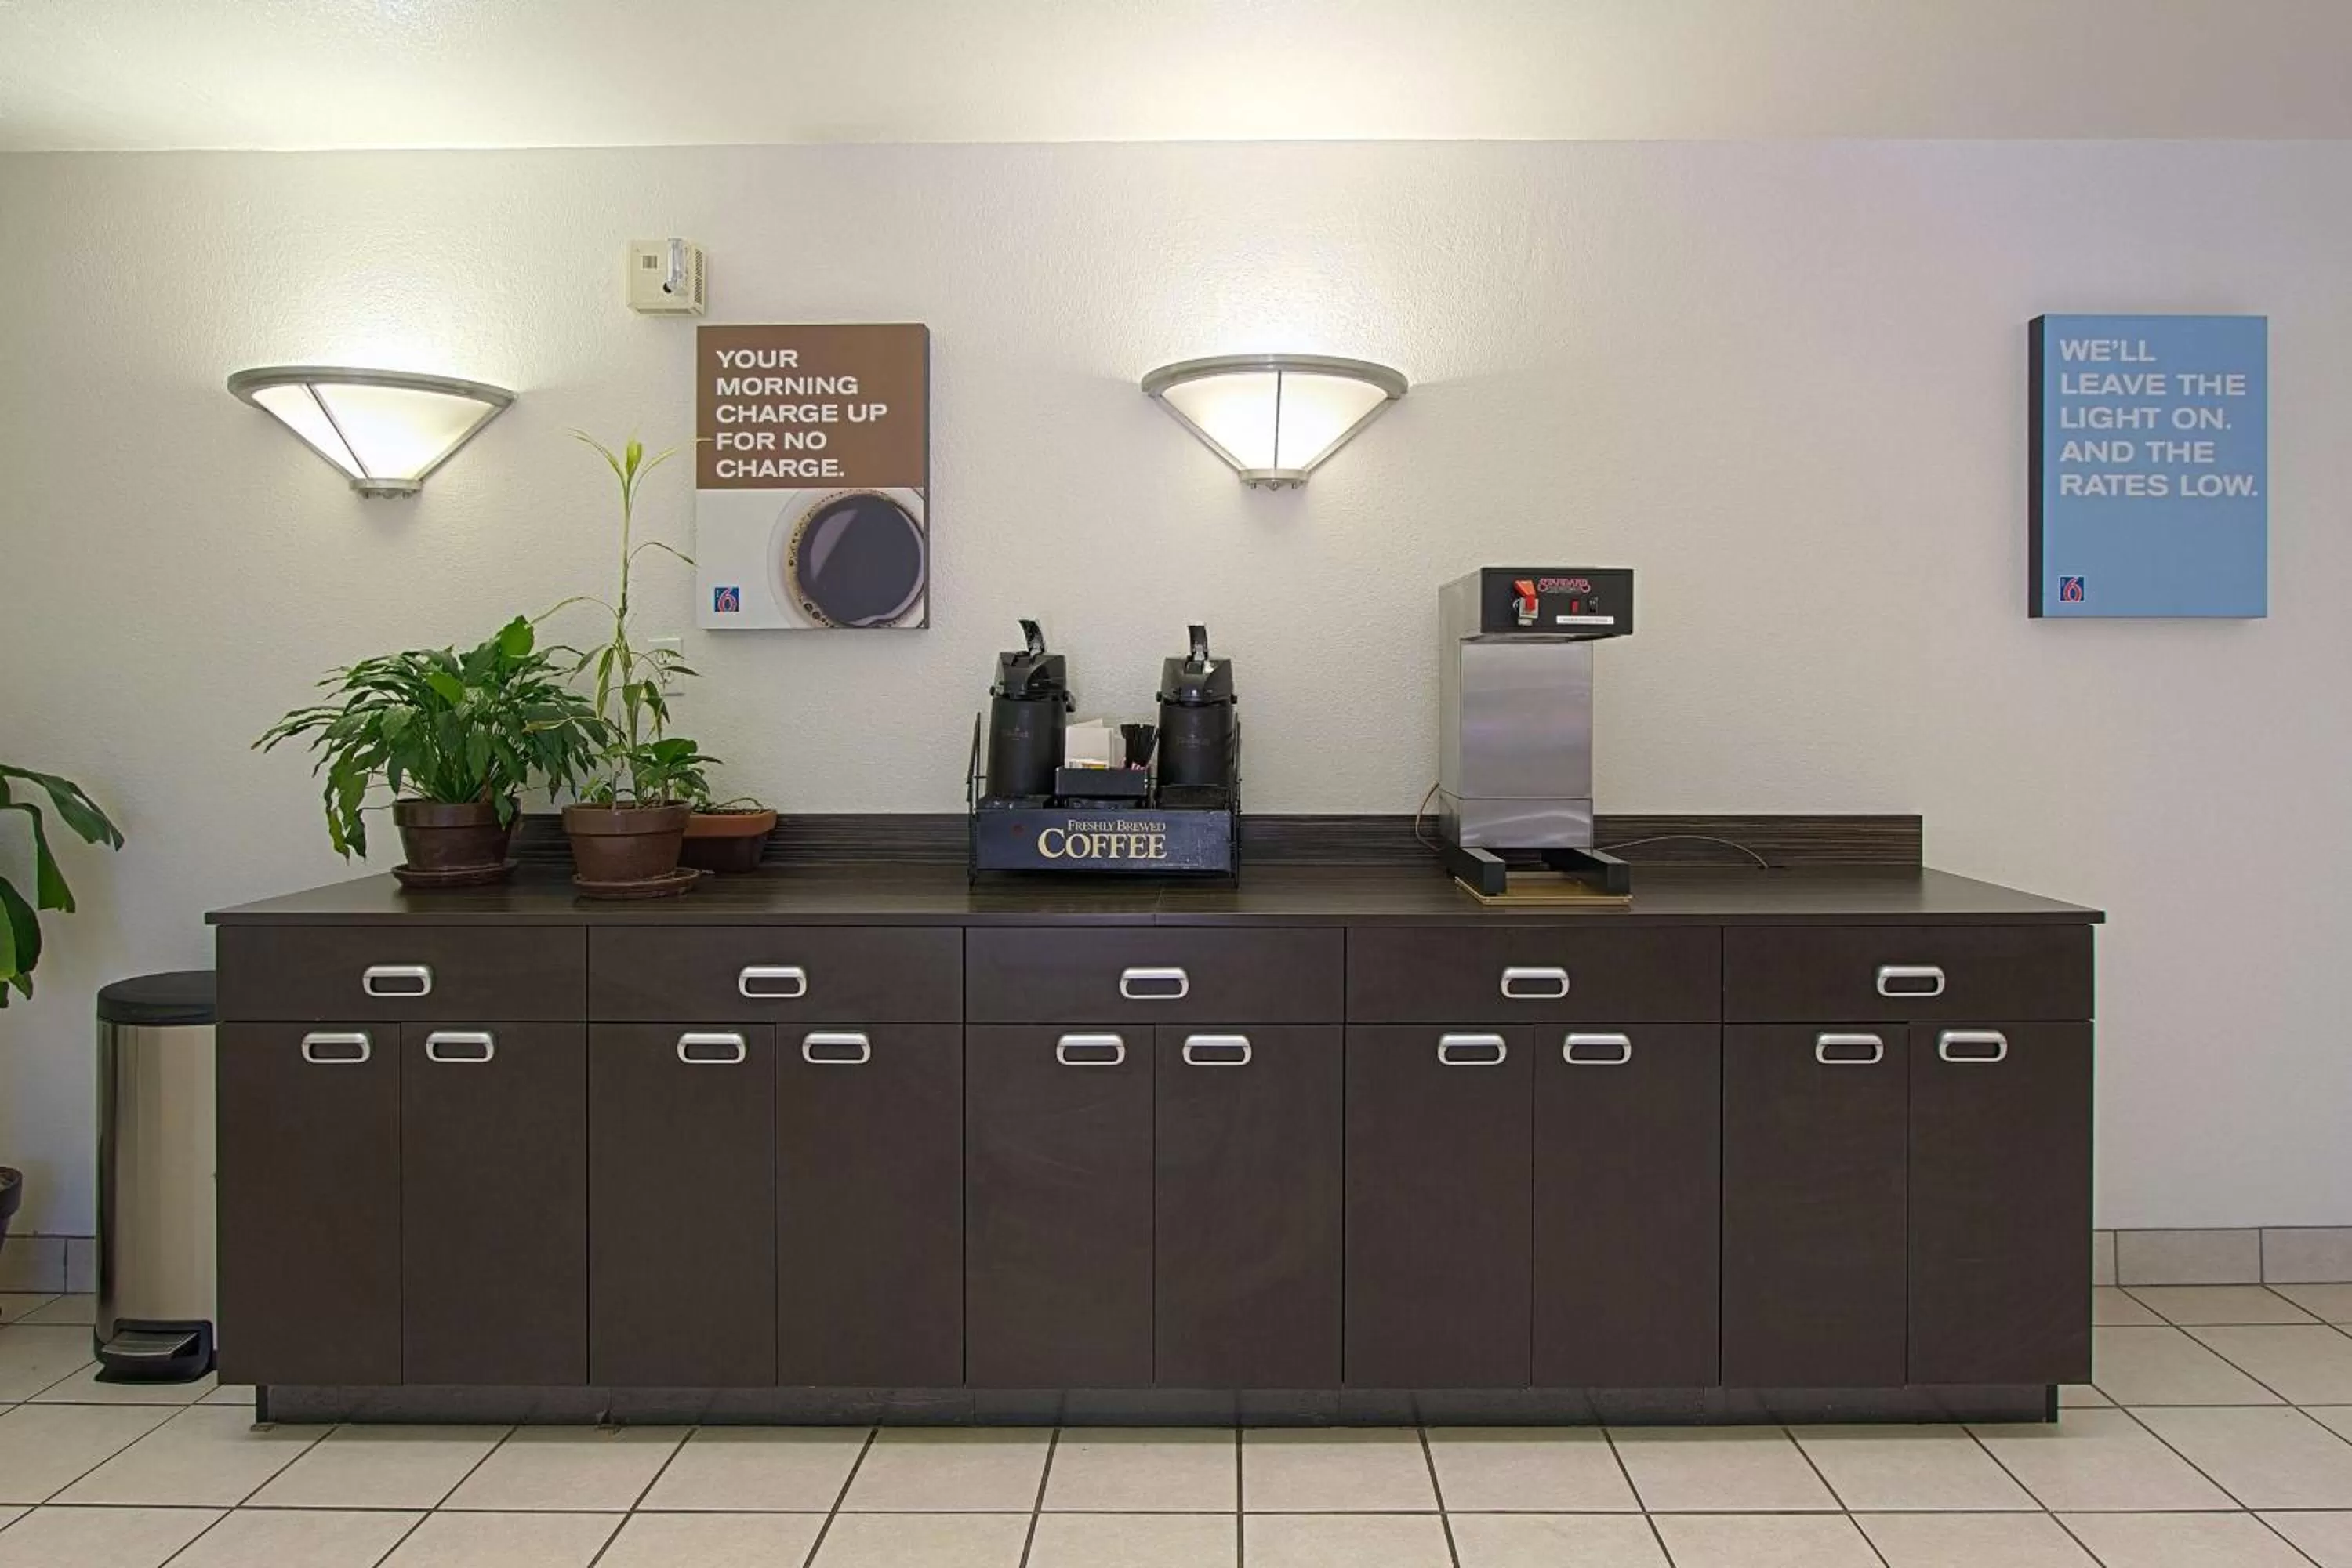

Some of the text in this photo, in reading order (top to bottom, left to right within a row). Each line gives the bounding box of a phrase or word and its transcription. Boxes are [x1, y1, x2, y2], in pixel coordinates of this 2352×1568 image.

[716, 349, 798, 369] YOUR
[2060, 339, 2156, 361] WE'LL
[716, 376, 858, 396] MORNING
[2060, 373, 2246, 396] LEAVE THE
[716, 403, 888, 423] CHARGE UP
[2060, 406, 2232, 430] LIGHT ON.
[716, 430, 827, 451] FOR NO
[2059, 441, 2215, 463] AND THE
[716, 459, 845, 478] CHARGE.
[2060, 474, 2258, 497] RATES LOW.
[717, 586, 737, 612] 6
[2063, 576, 2082, 602] 6
[1068, 819, 1166, 833] FRESHLY BREWED
[1037, 827, 1167, 859] COFFEE
